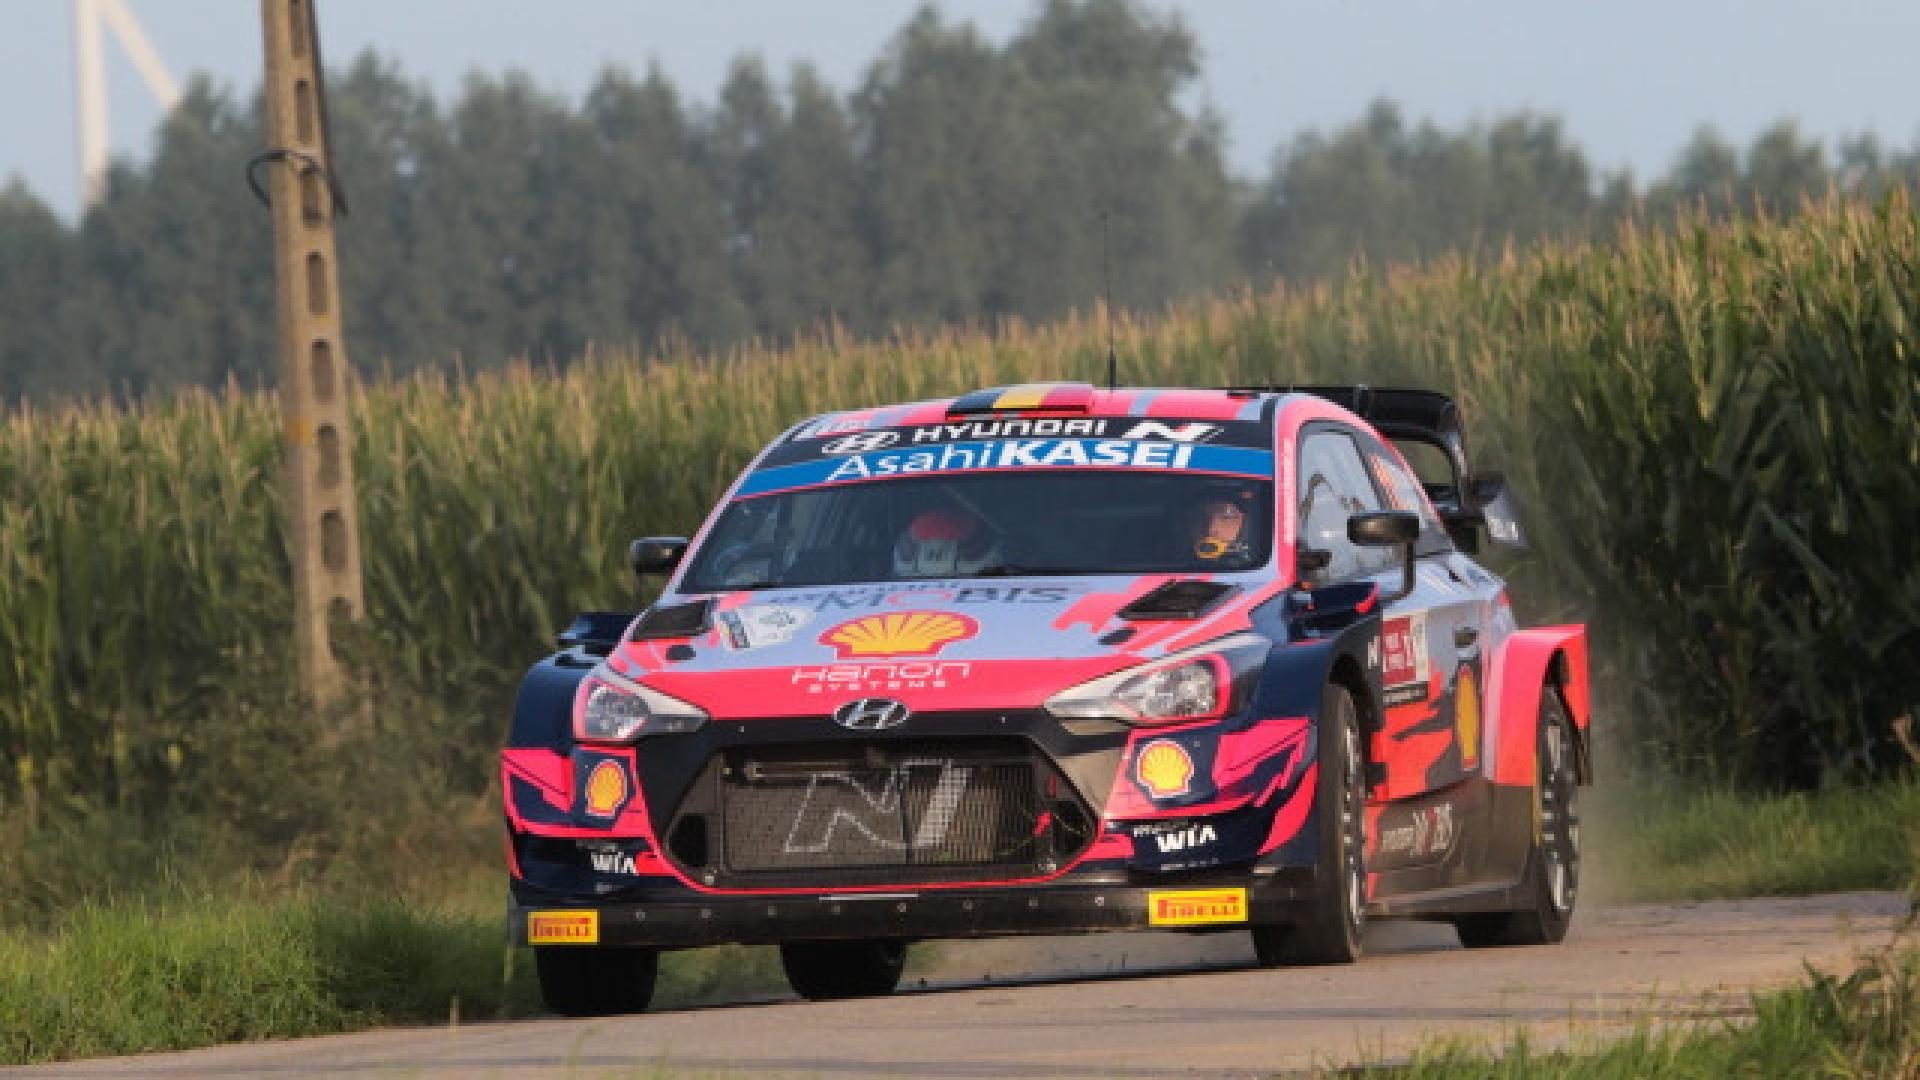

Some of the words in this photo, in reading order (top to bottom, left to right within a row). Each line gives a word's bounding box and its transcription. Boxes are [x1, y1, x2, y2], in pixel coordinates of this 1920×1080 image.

[912, 419, 1107, 442] HYUNDAI
[1157, 826, 1218, 852] WIA
[591, 852, 639, 876] WIA
[1158, 896, 1240, 919] PIRELLI
[534, 917, 592, 938] PIRELLI
